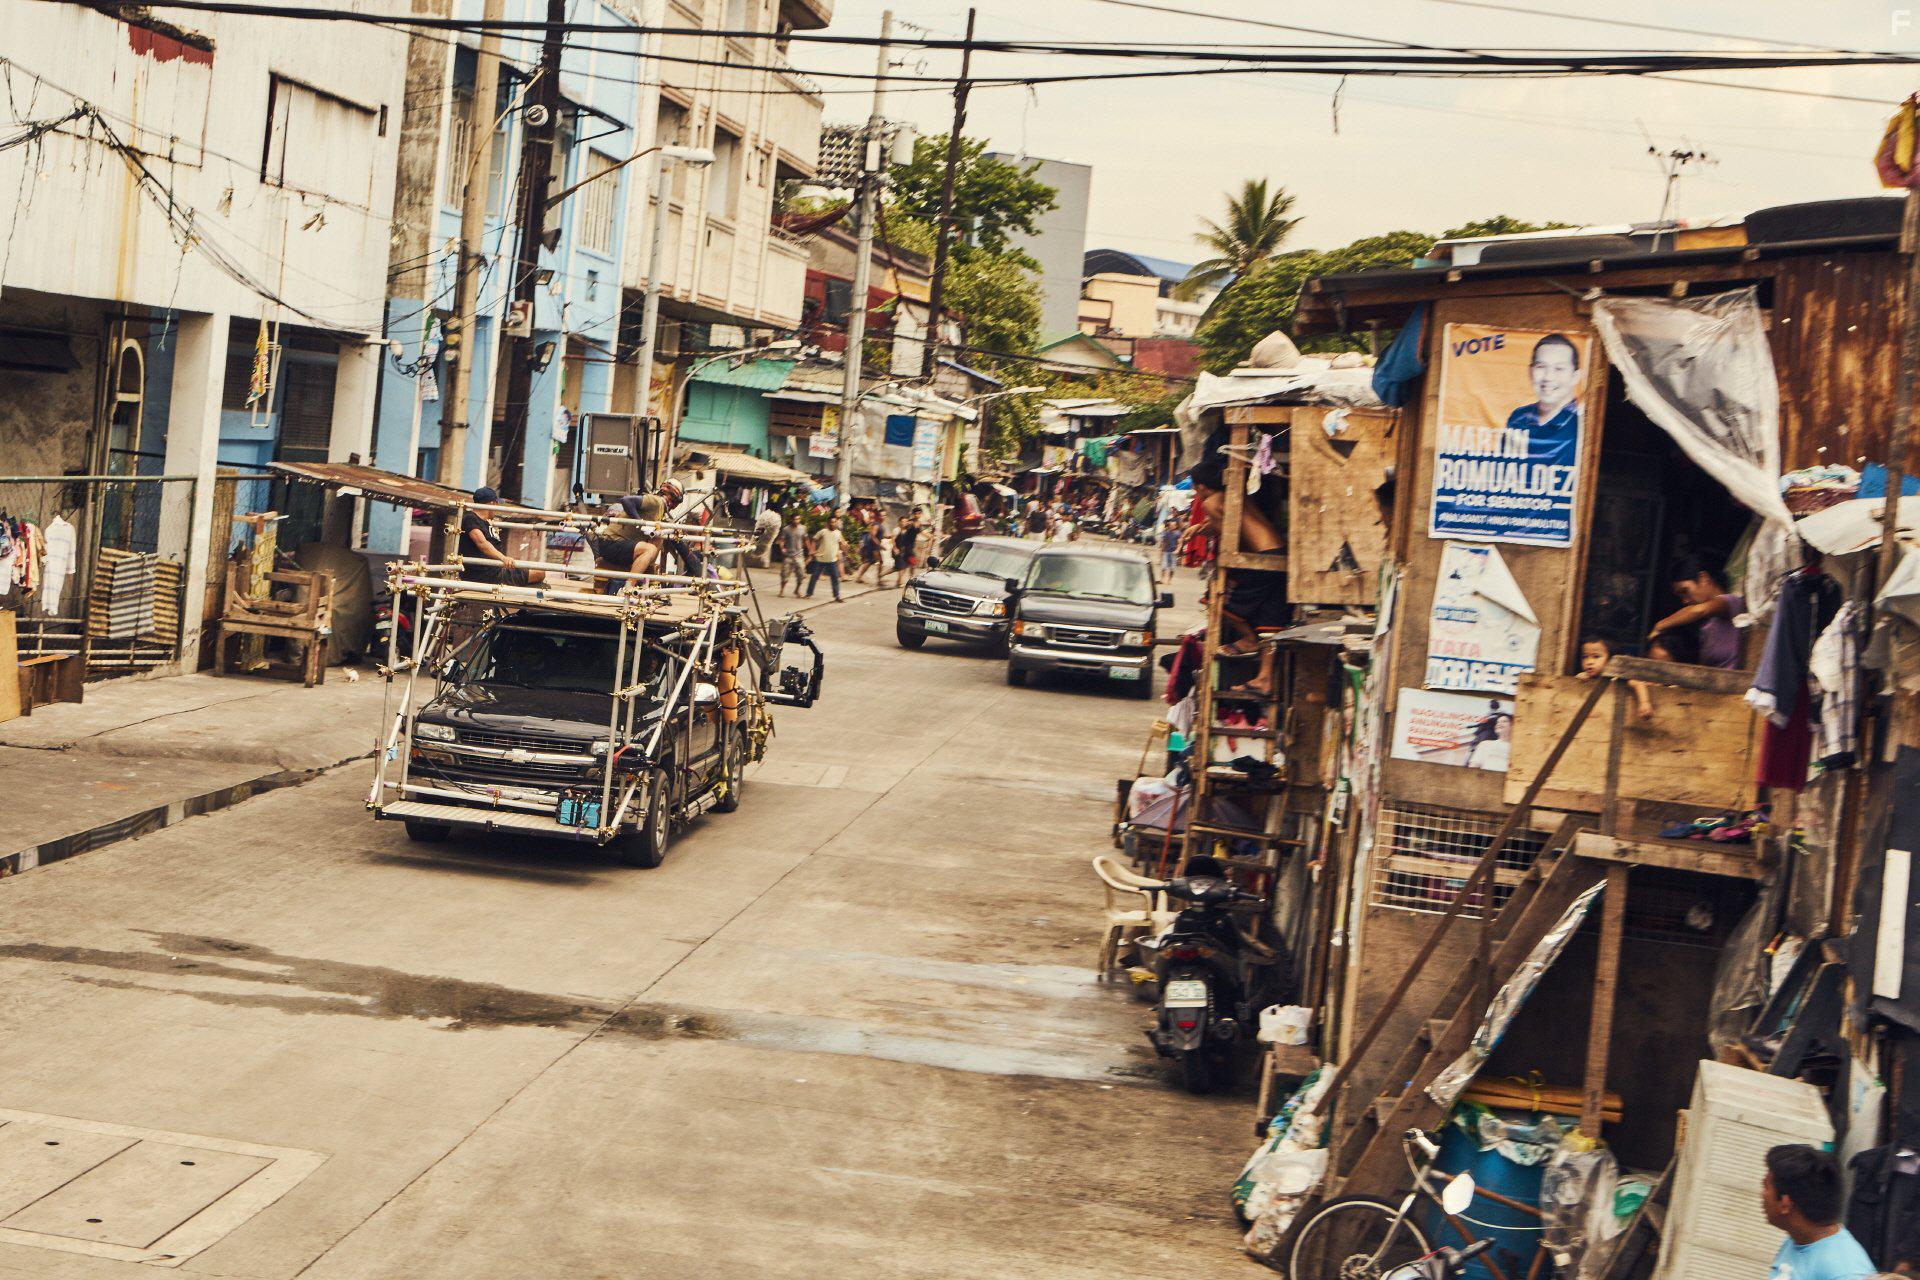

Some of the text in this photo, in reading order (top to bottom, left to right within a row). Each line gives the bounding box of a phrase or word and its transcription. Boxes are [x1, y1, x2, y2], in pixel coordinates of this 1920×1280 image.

[1452, 334, 1505, 357] VOTE
[1439, 424, 1530, 460] MARTIN
[1436, 458, 1577, 497] ROMUALDEZ
[1455, 493, 1554, 512] FOR SENATOR
